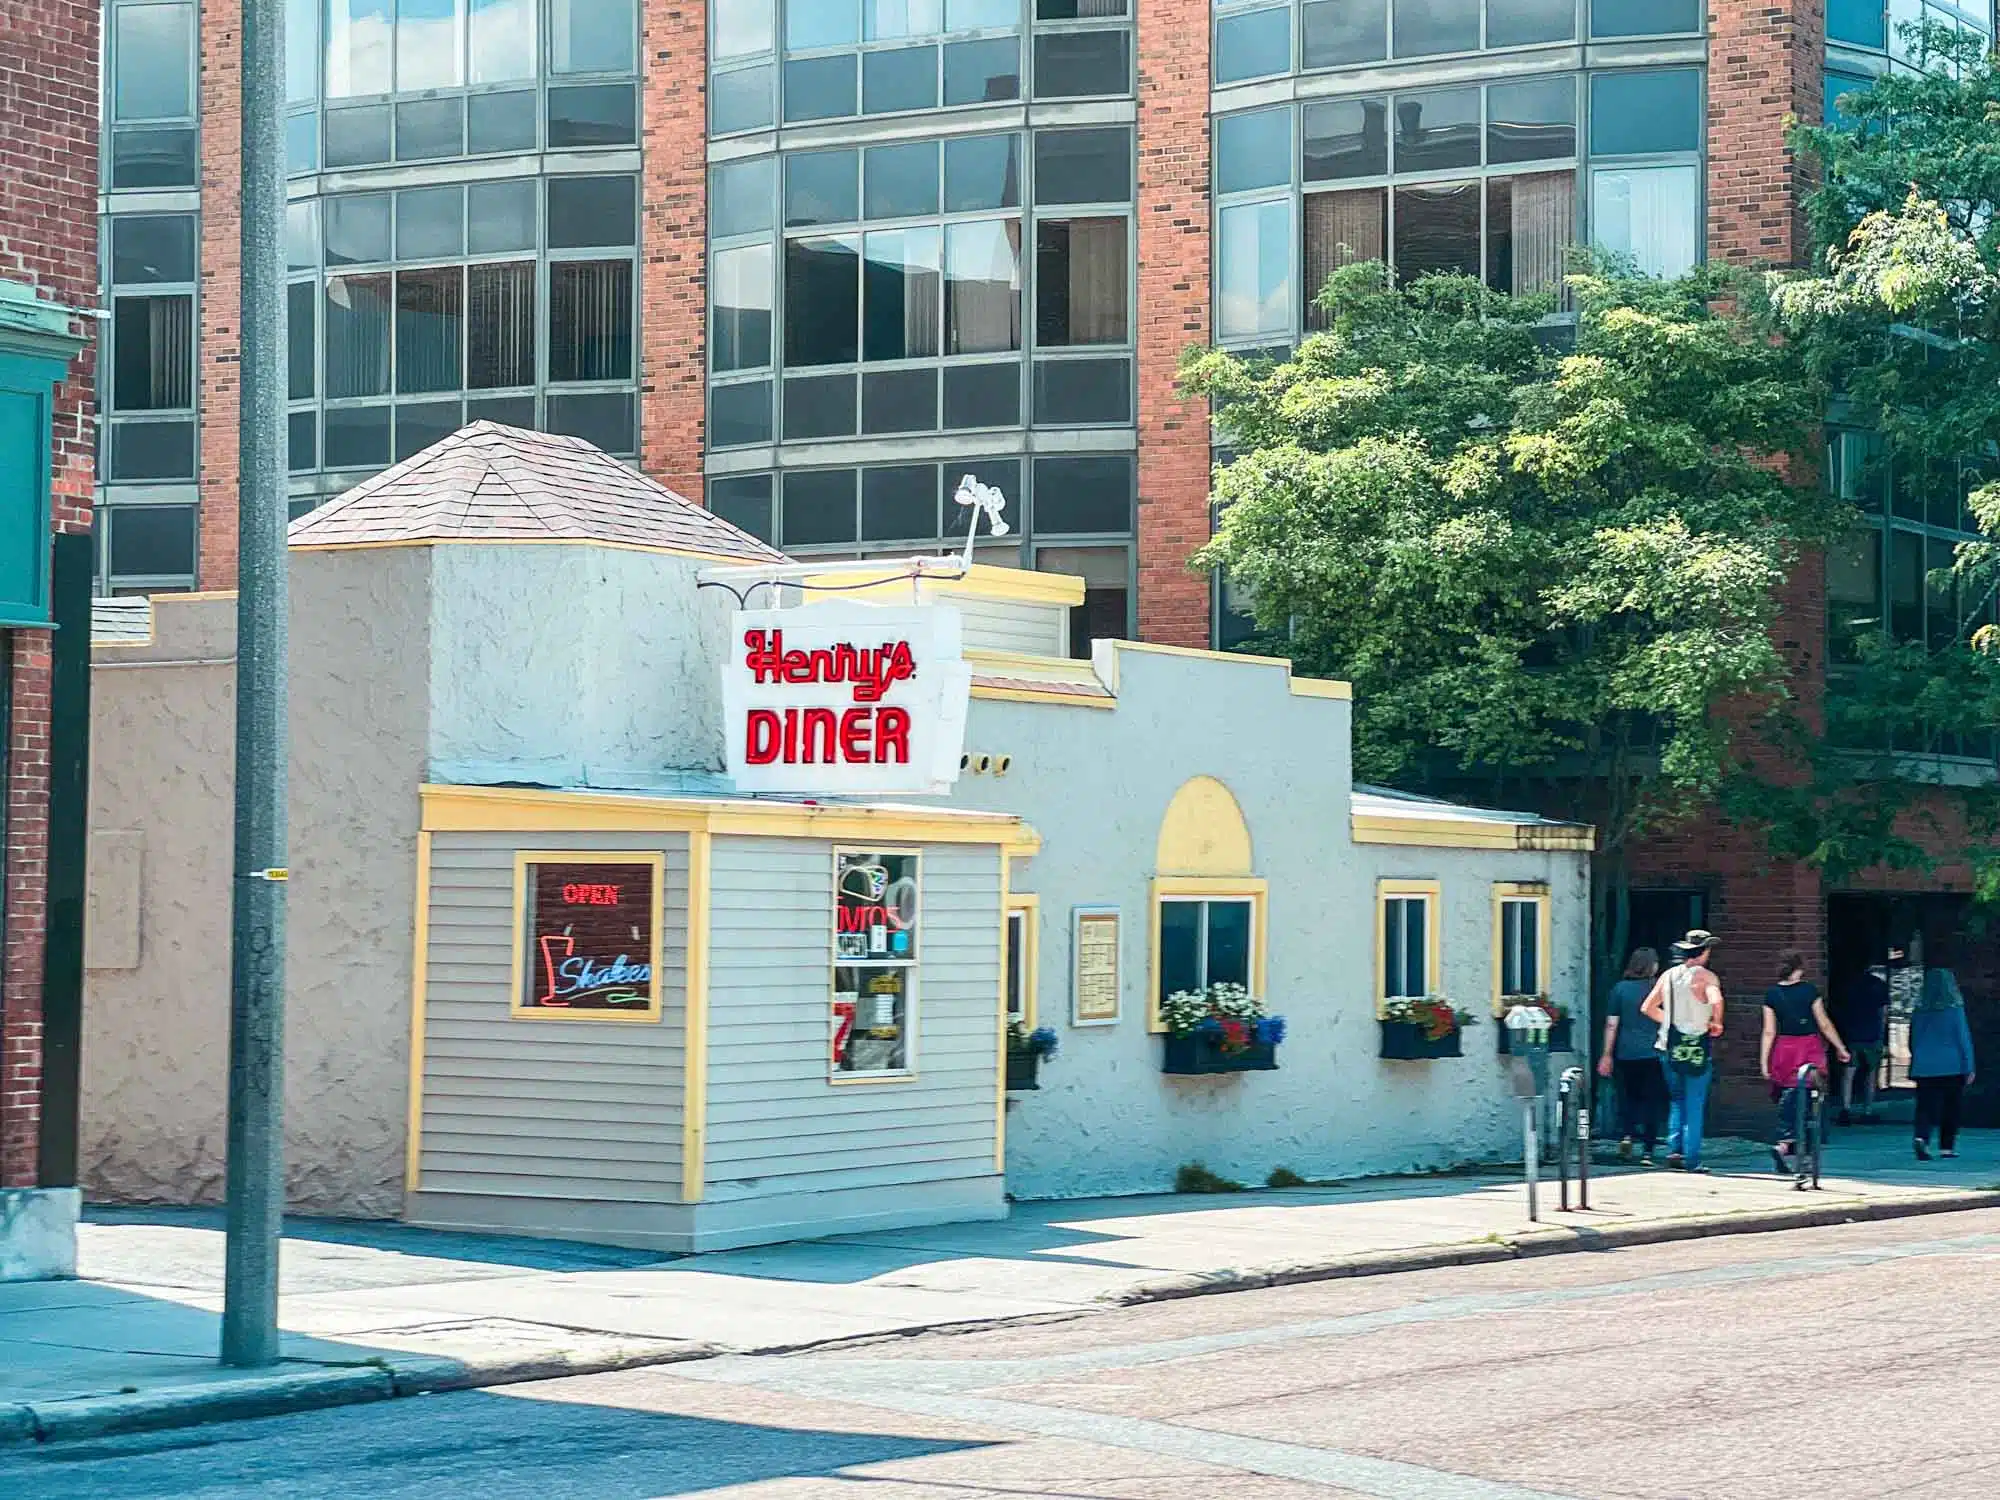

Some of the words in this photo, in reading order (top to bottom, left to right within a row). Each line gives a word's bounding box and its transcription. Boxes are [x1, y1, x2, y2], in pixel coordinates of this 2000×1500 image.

[744, 629, 913, 702] Henry's
[745, 706, 911, 764] DINER
[562, 883, 621, 905] OPEN
[555, 954, 651, 994] Shakes
